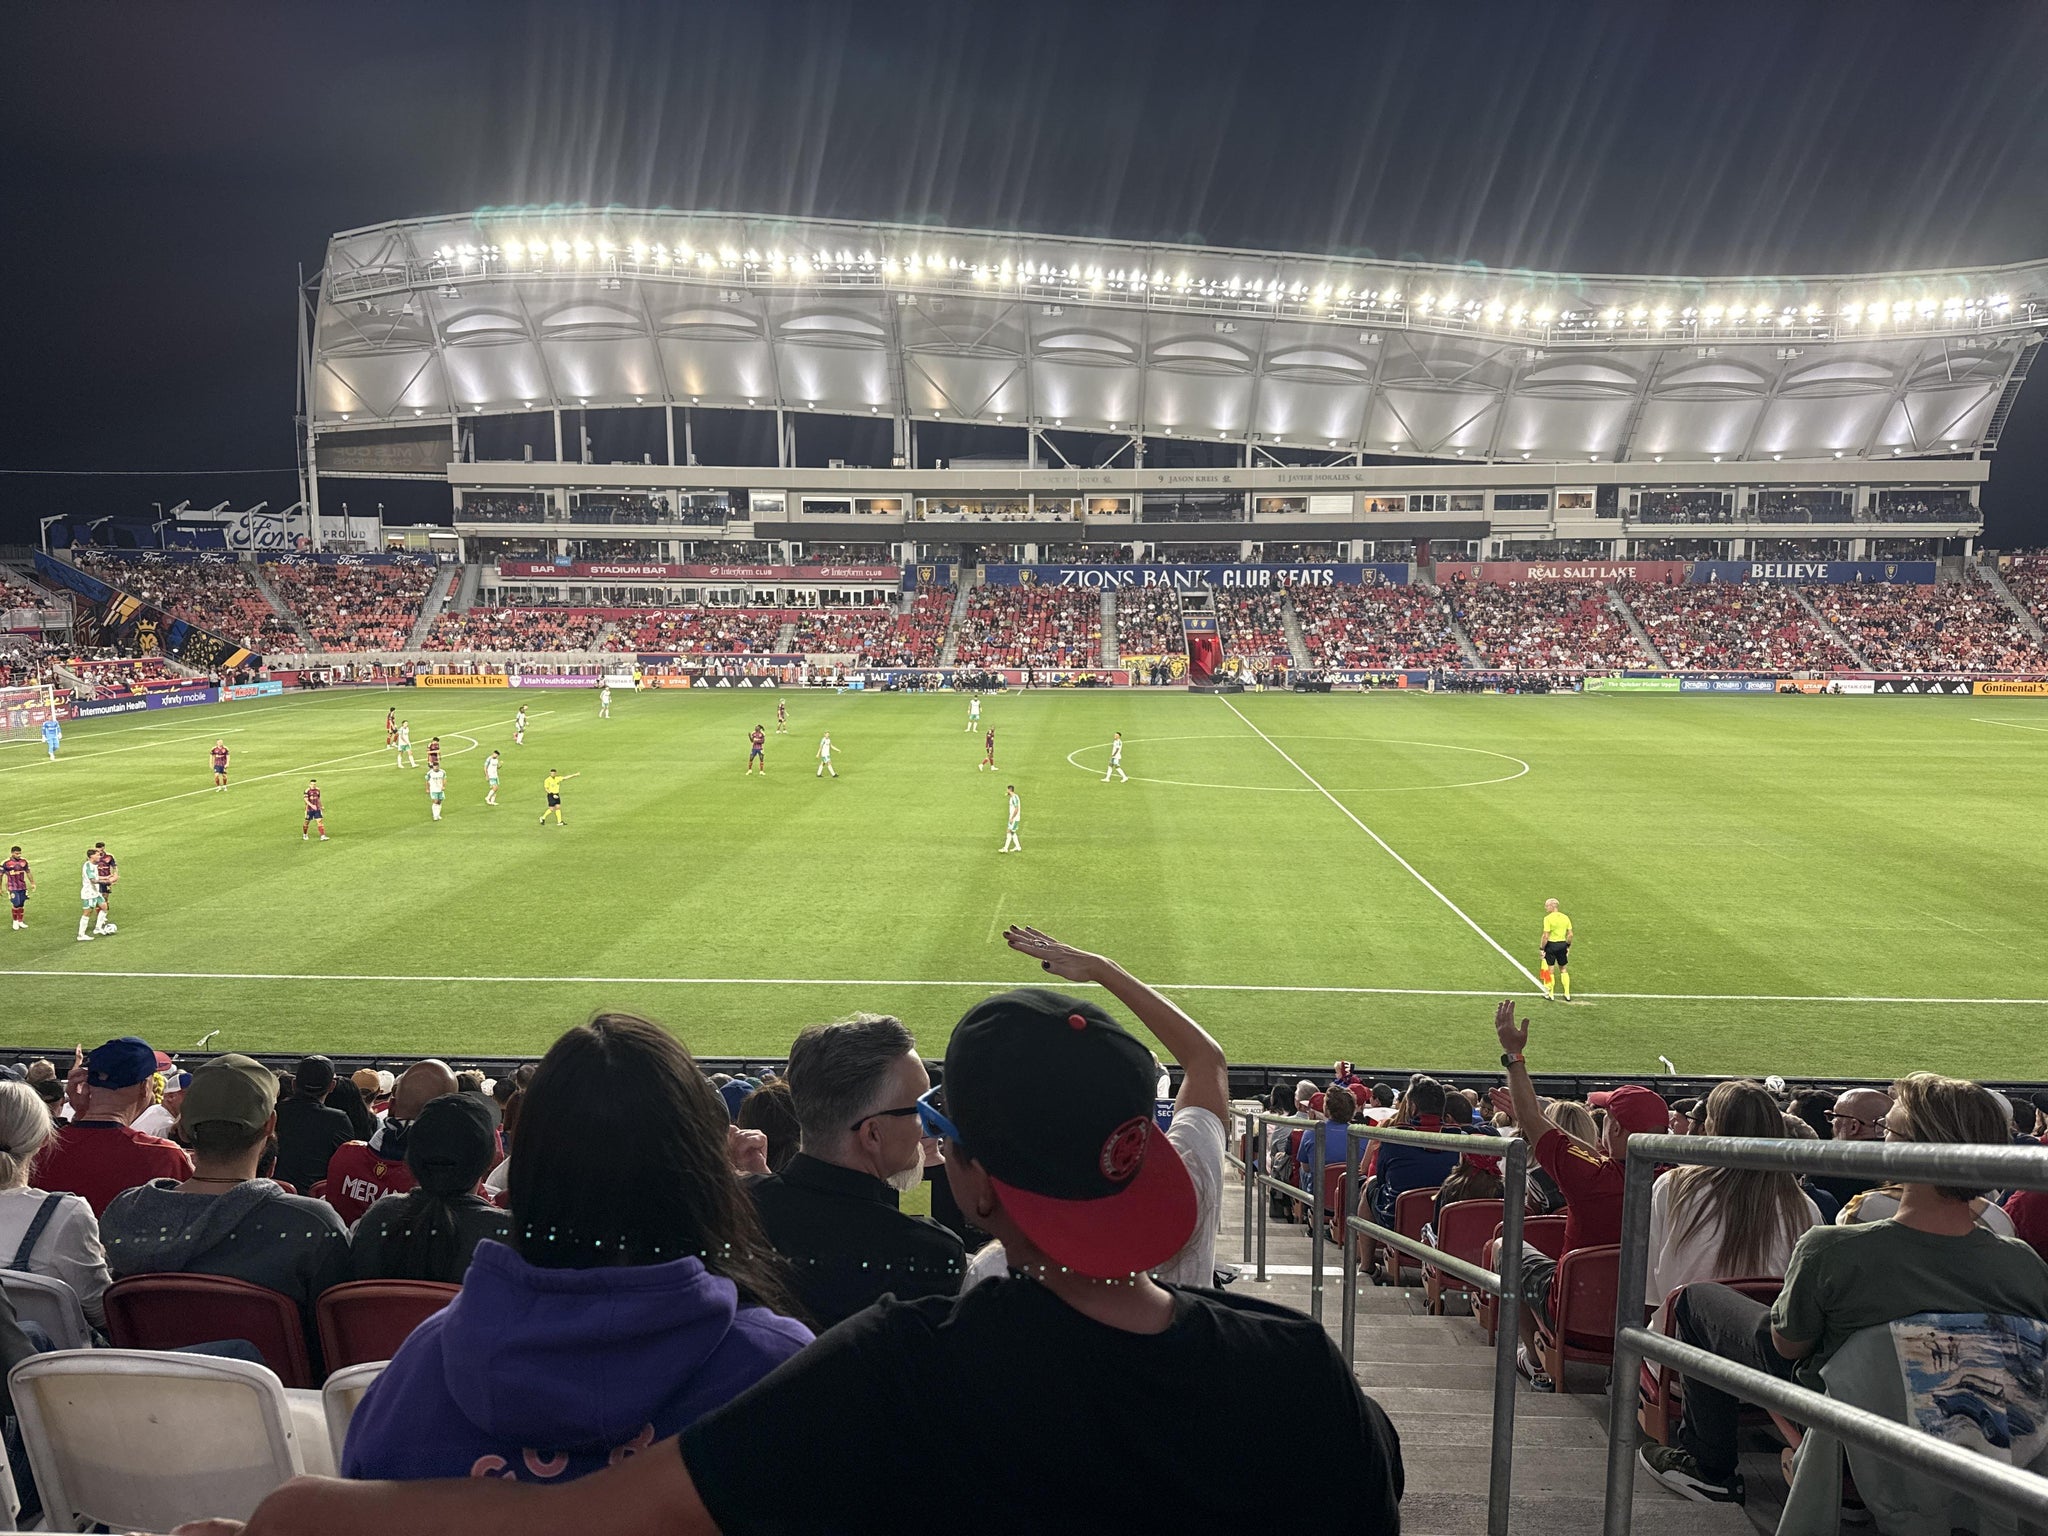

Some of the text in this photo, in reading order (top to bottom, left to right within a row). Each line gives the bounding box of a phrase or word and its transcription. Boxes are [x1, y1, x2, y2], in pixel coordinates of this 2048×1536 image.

[1158, 475, 1164, 483] 9
[1168, 475, 1194, 483] JASON
[323, 530, 366, 539] PROUD
[337, 554, 364, 565] Ford
[531, 565, 555, 573] BAR
[590, 566, 667, 574] STADIUM BAR
[721, 567, 753, 576] Interform
[831, 568, 864, 577] Interform
[1563, 567, 1597, 578] SALT
[1600, 567, 1636, 578] LAKE
[1751, 563, 1828, 578] BELIEVE
[1060, 569, 1334, 589] ZIONS BANK CLUB SEATS
[424, 676, 473, 686] Continental
[481, 676, 503, 685] Tire
[1982, 683, 2036, 693] Continental
[161, 692, 206, 706] xfinity mobile
[80, 701, 125, 716] Intermountain
[126, 700, 147, 711] Health
[341, 1175, 398, 1202] MER
